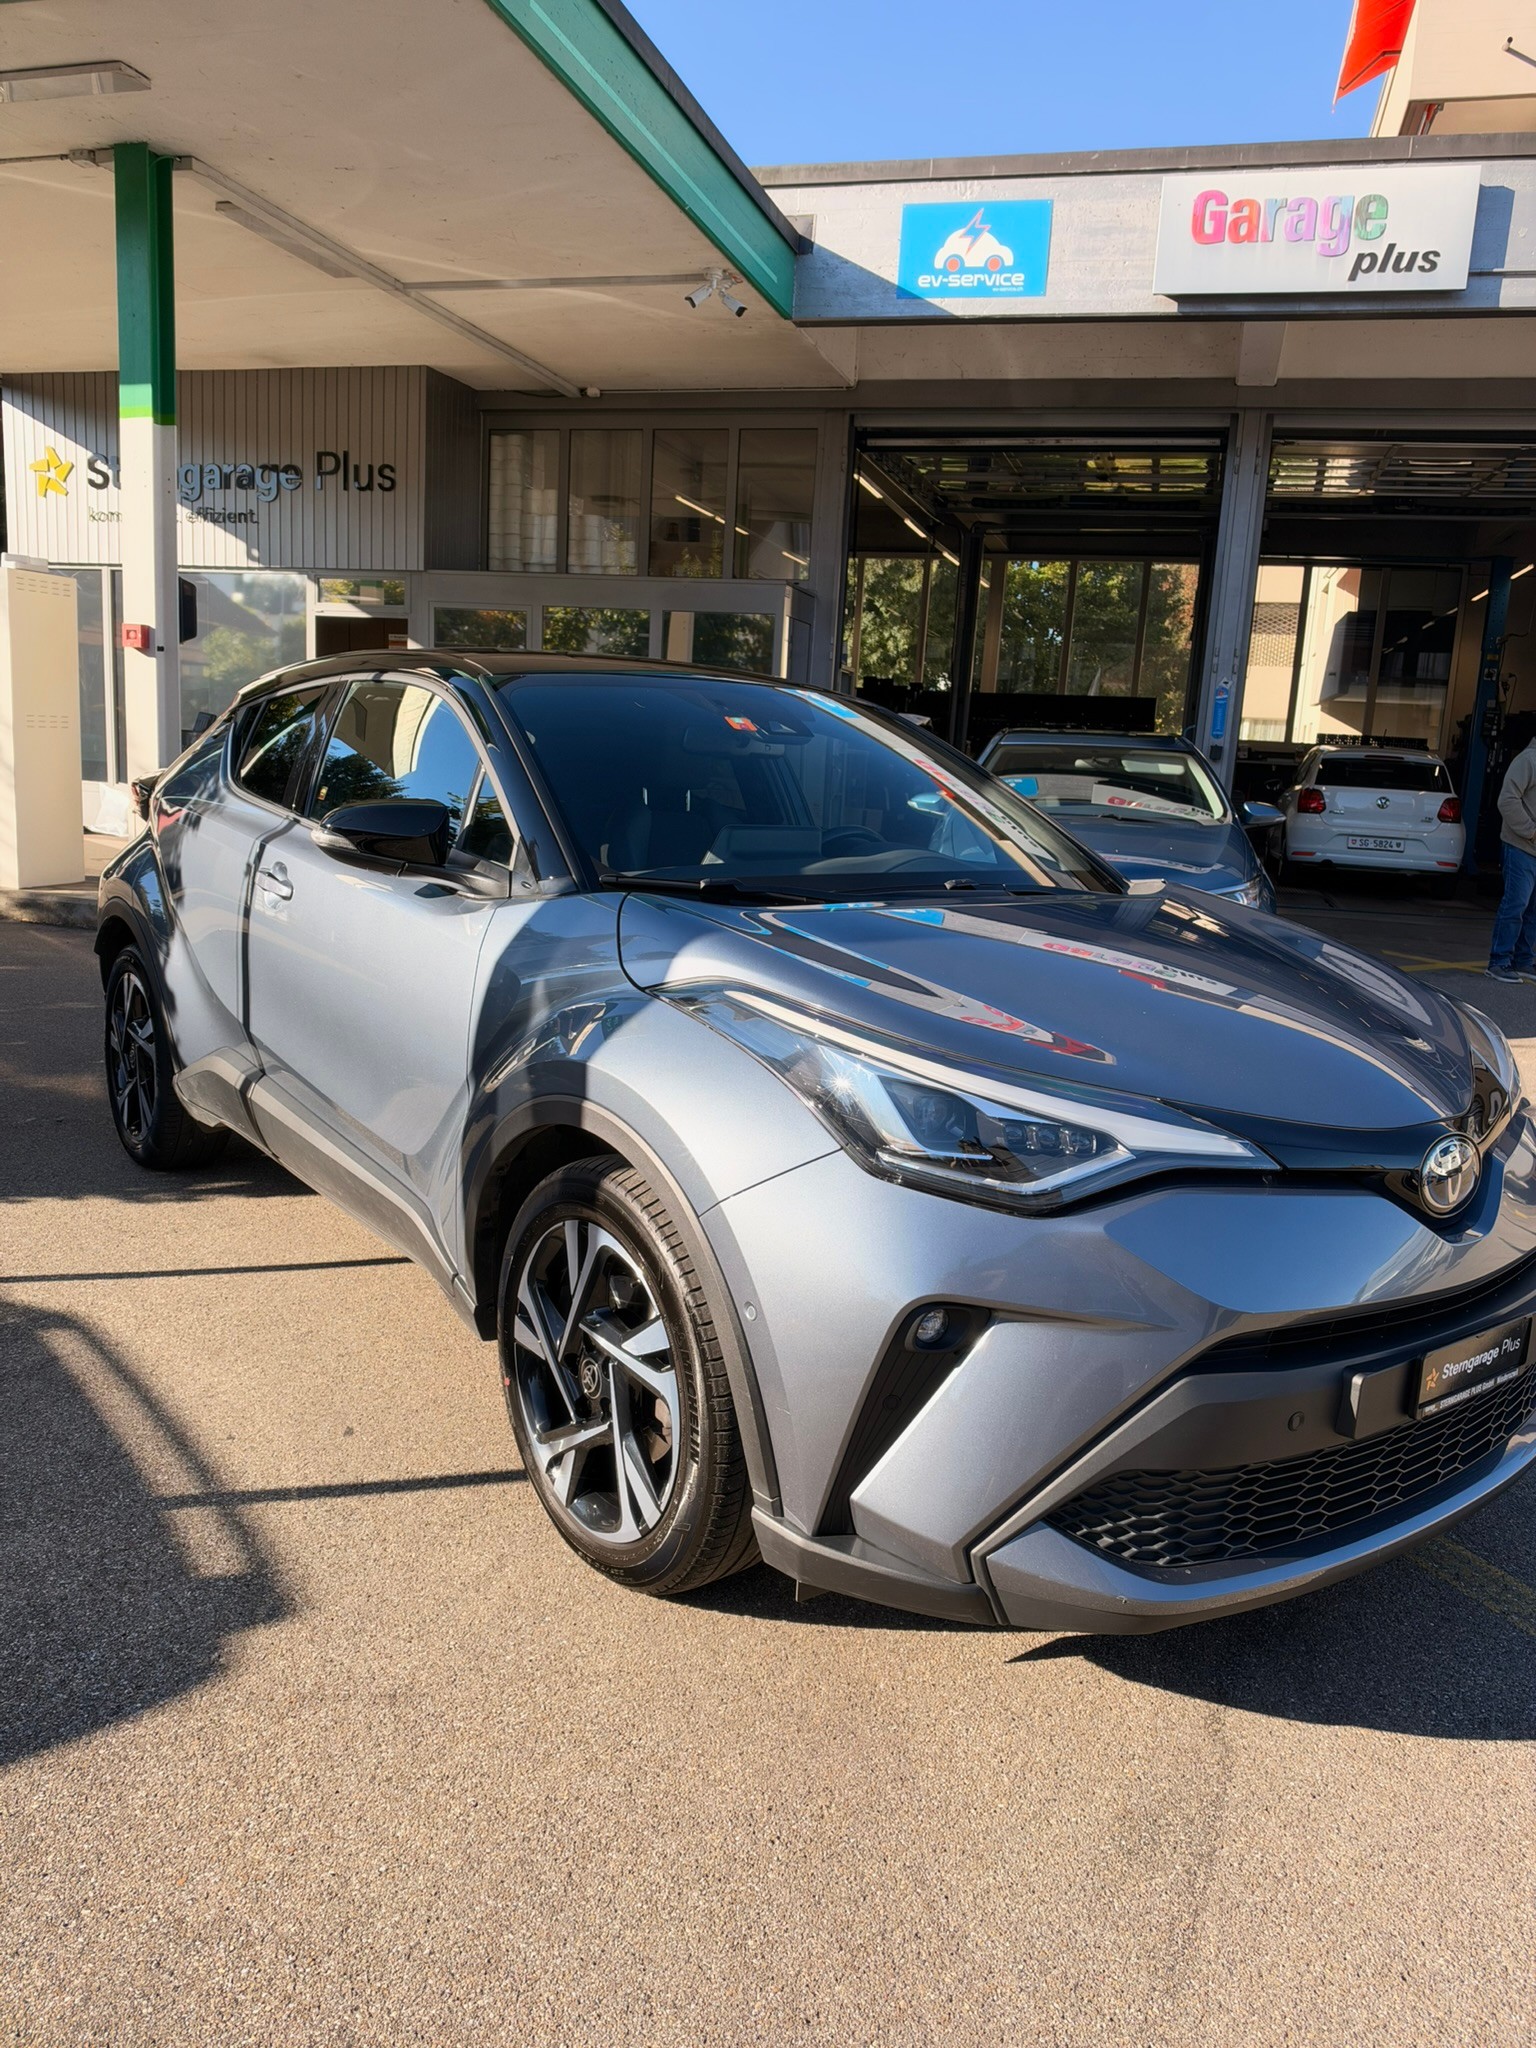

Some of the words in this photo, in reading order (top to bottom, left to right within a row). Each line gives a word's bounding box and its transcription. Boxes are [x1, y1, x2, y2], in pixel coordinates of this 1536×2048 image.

[1191, 189, 1389, 257] Garage
[917, 273, 1025, 288] ev-service
[1347, 242, 1441, 282] plus
[87, 451, 303, 502] Stgarage
[316, 450, 397, 492] Plus
[1442, 1347, 1499, 1379] Sterngarage
[1501, 1337, 1521, 1355] Plus
[681, 1350, 700, 1465] MICHELIN
